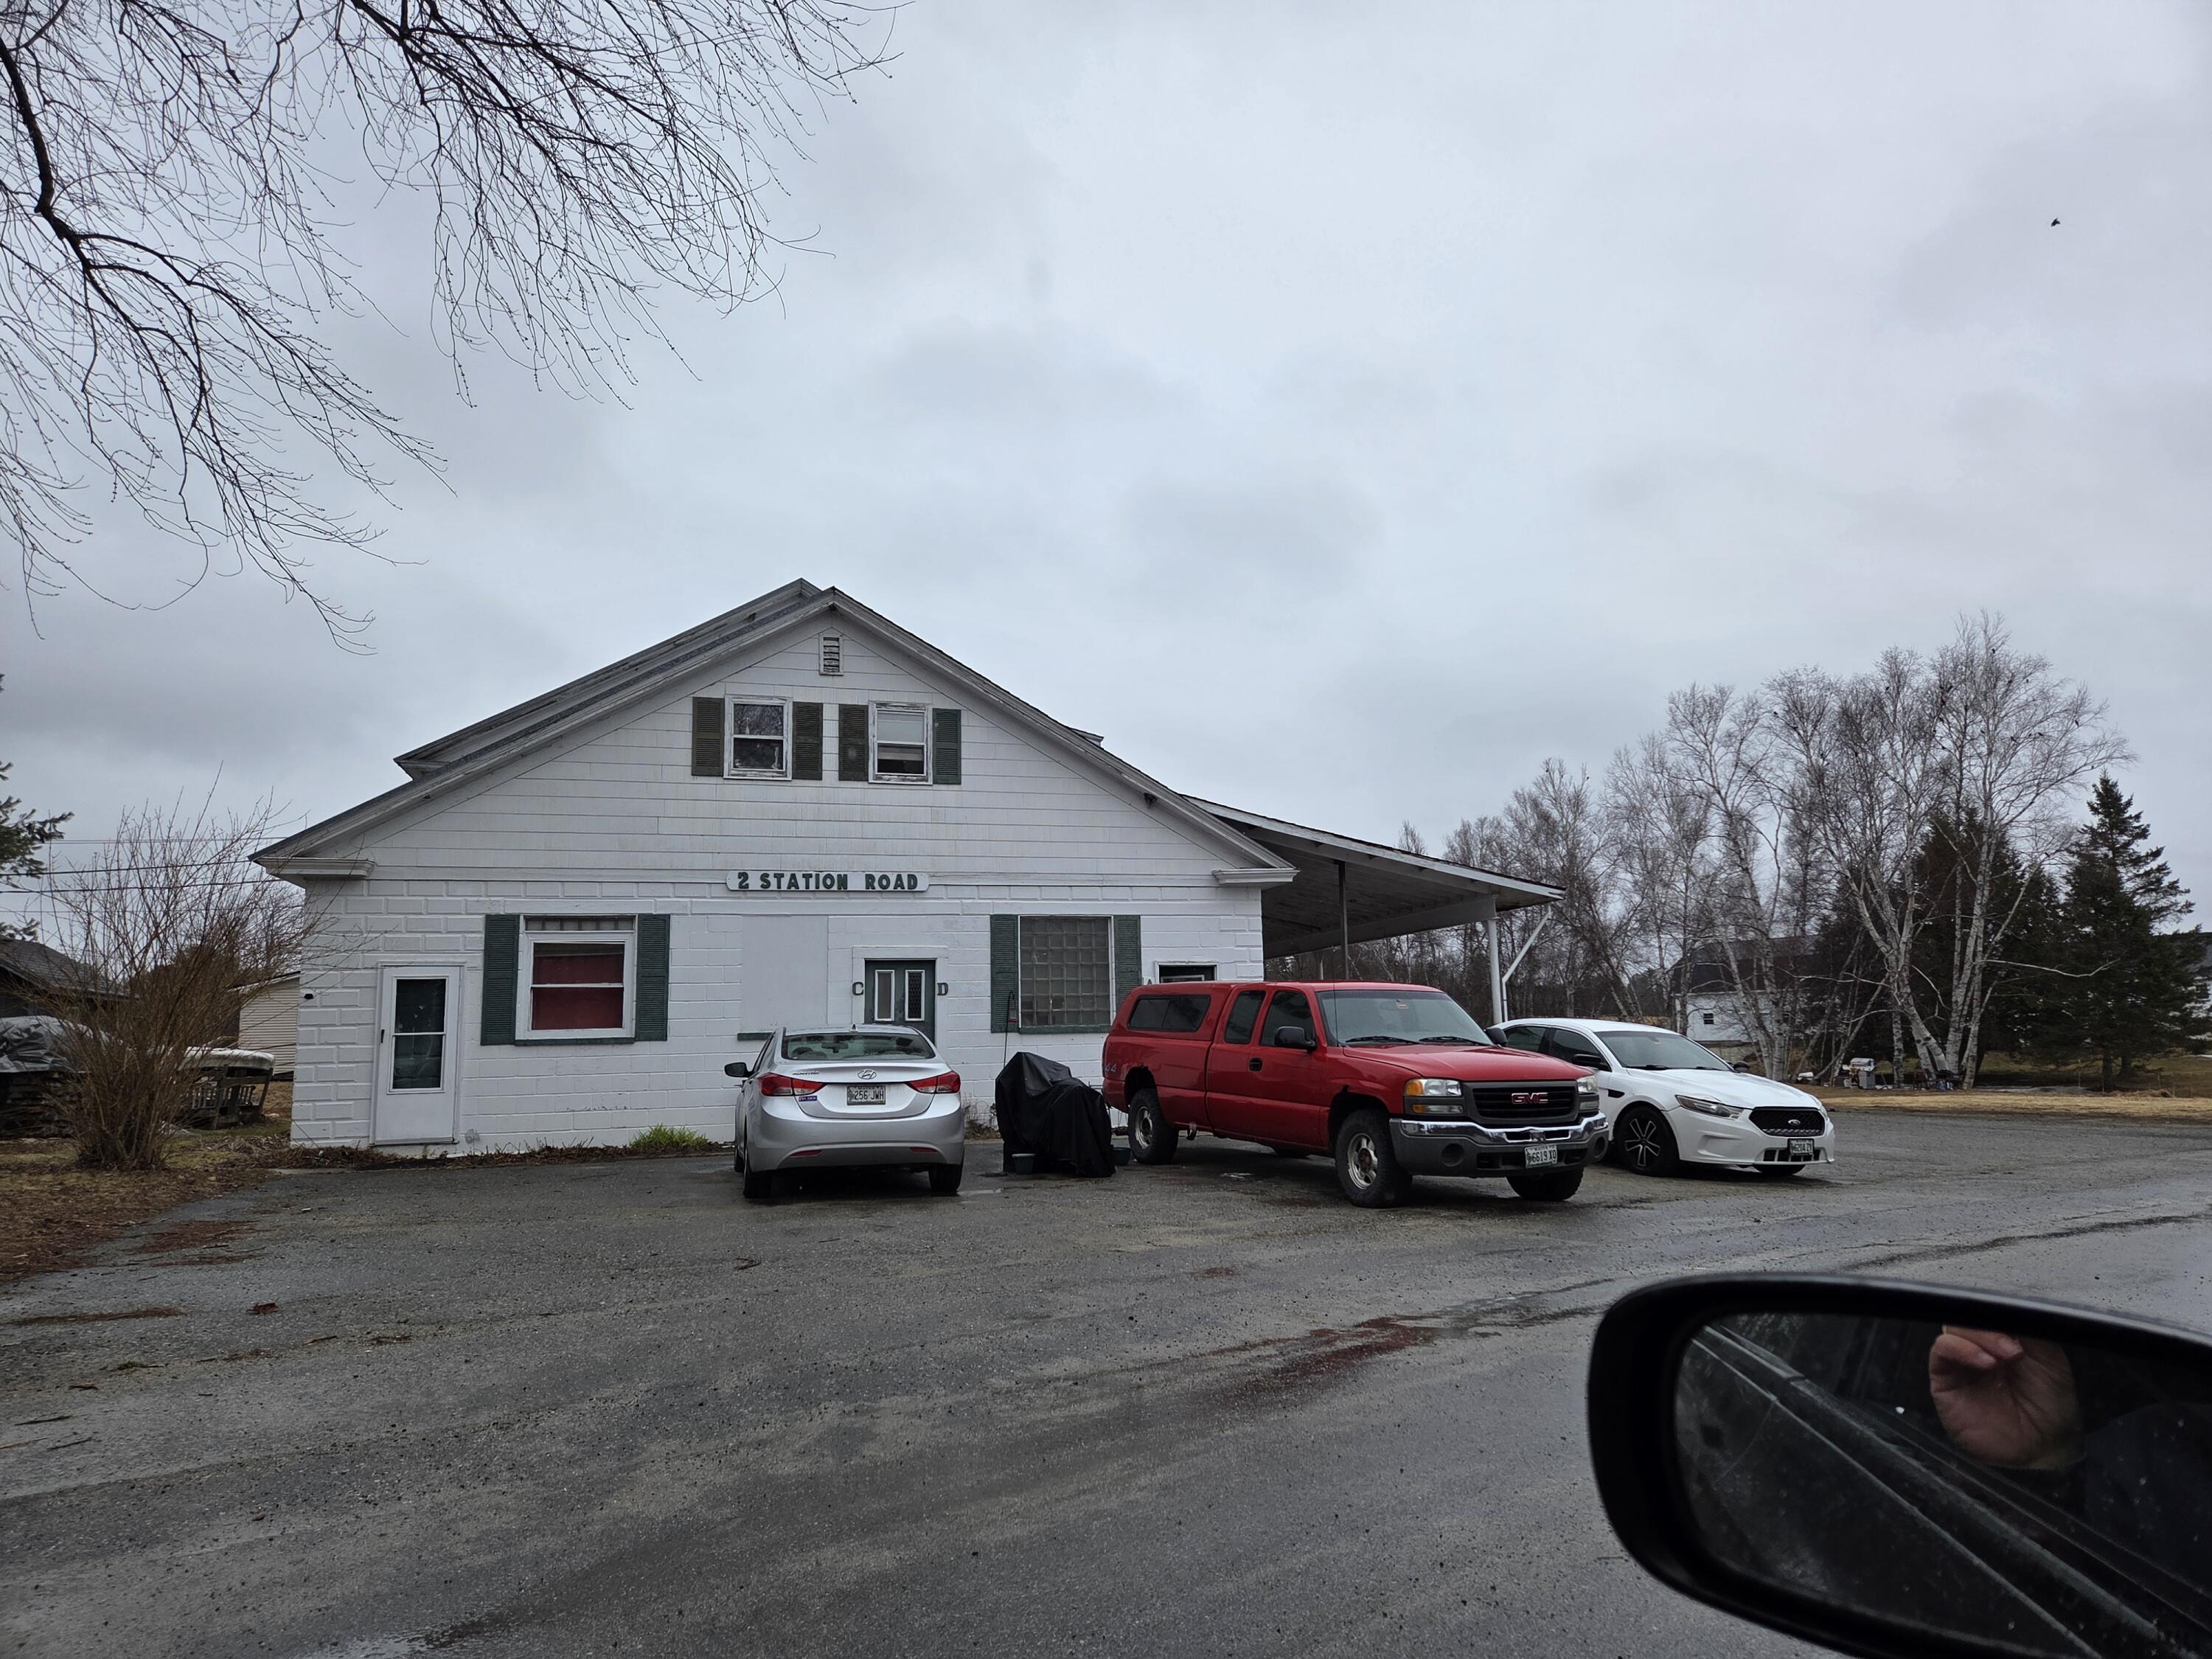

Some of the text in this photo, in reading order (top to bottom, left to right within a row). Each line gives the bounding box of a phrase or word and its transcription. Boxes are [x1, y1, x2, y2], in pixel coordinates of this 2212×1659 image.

[737, 872, 918, 890] 2 STATION ROAD
[852, 981, 864, 995] C
[936, 982, 949, 996] D
[854, 1090, 869, 1100] 256
[1511, 1092, 1548, 1105] GMC
